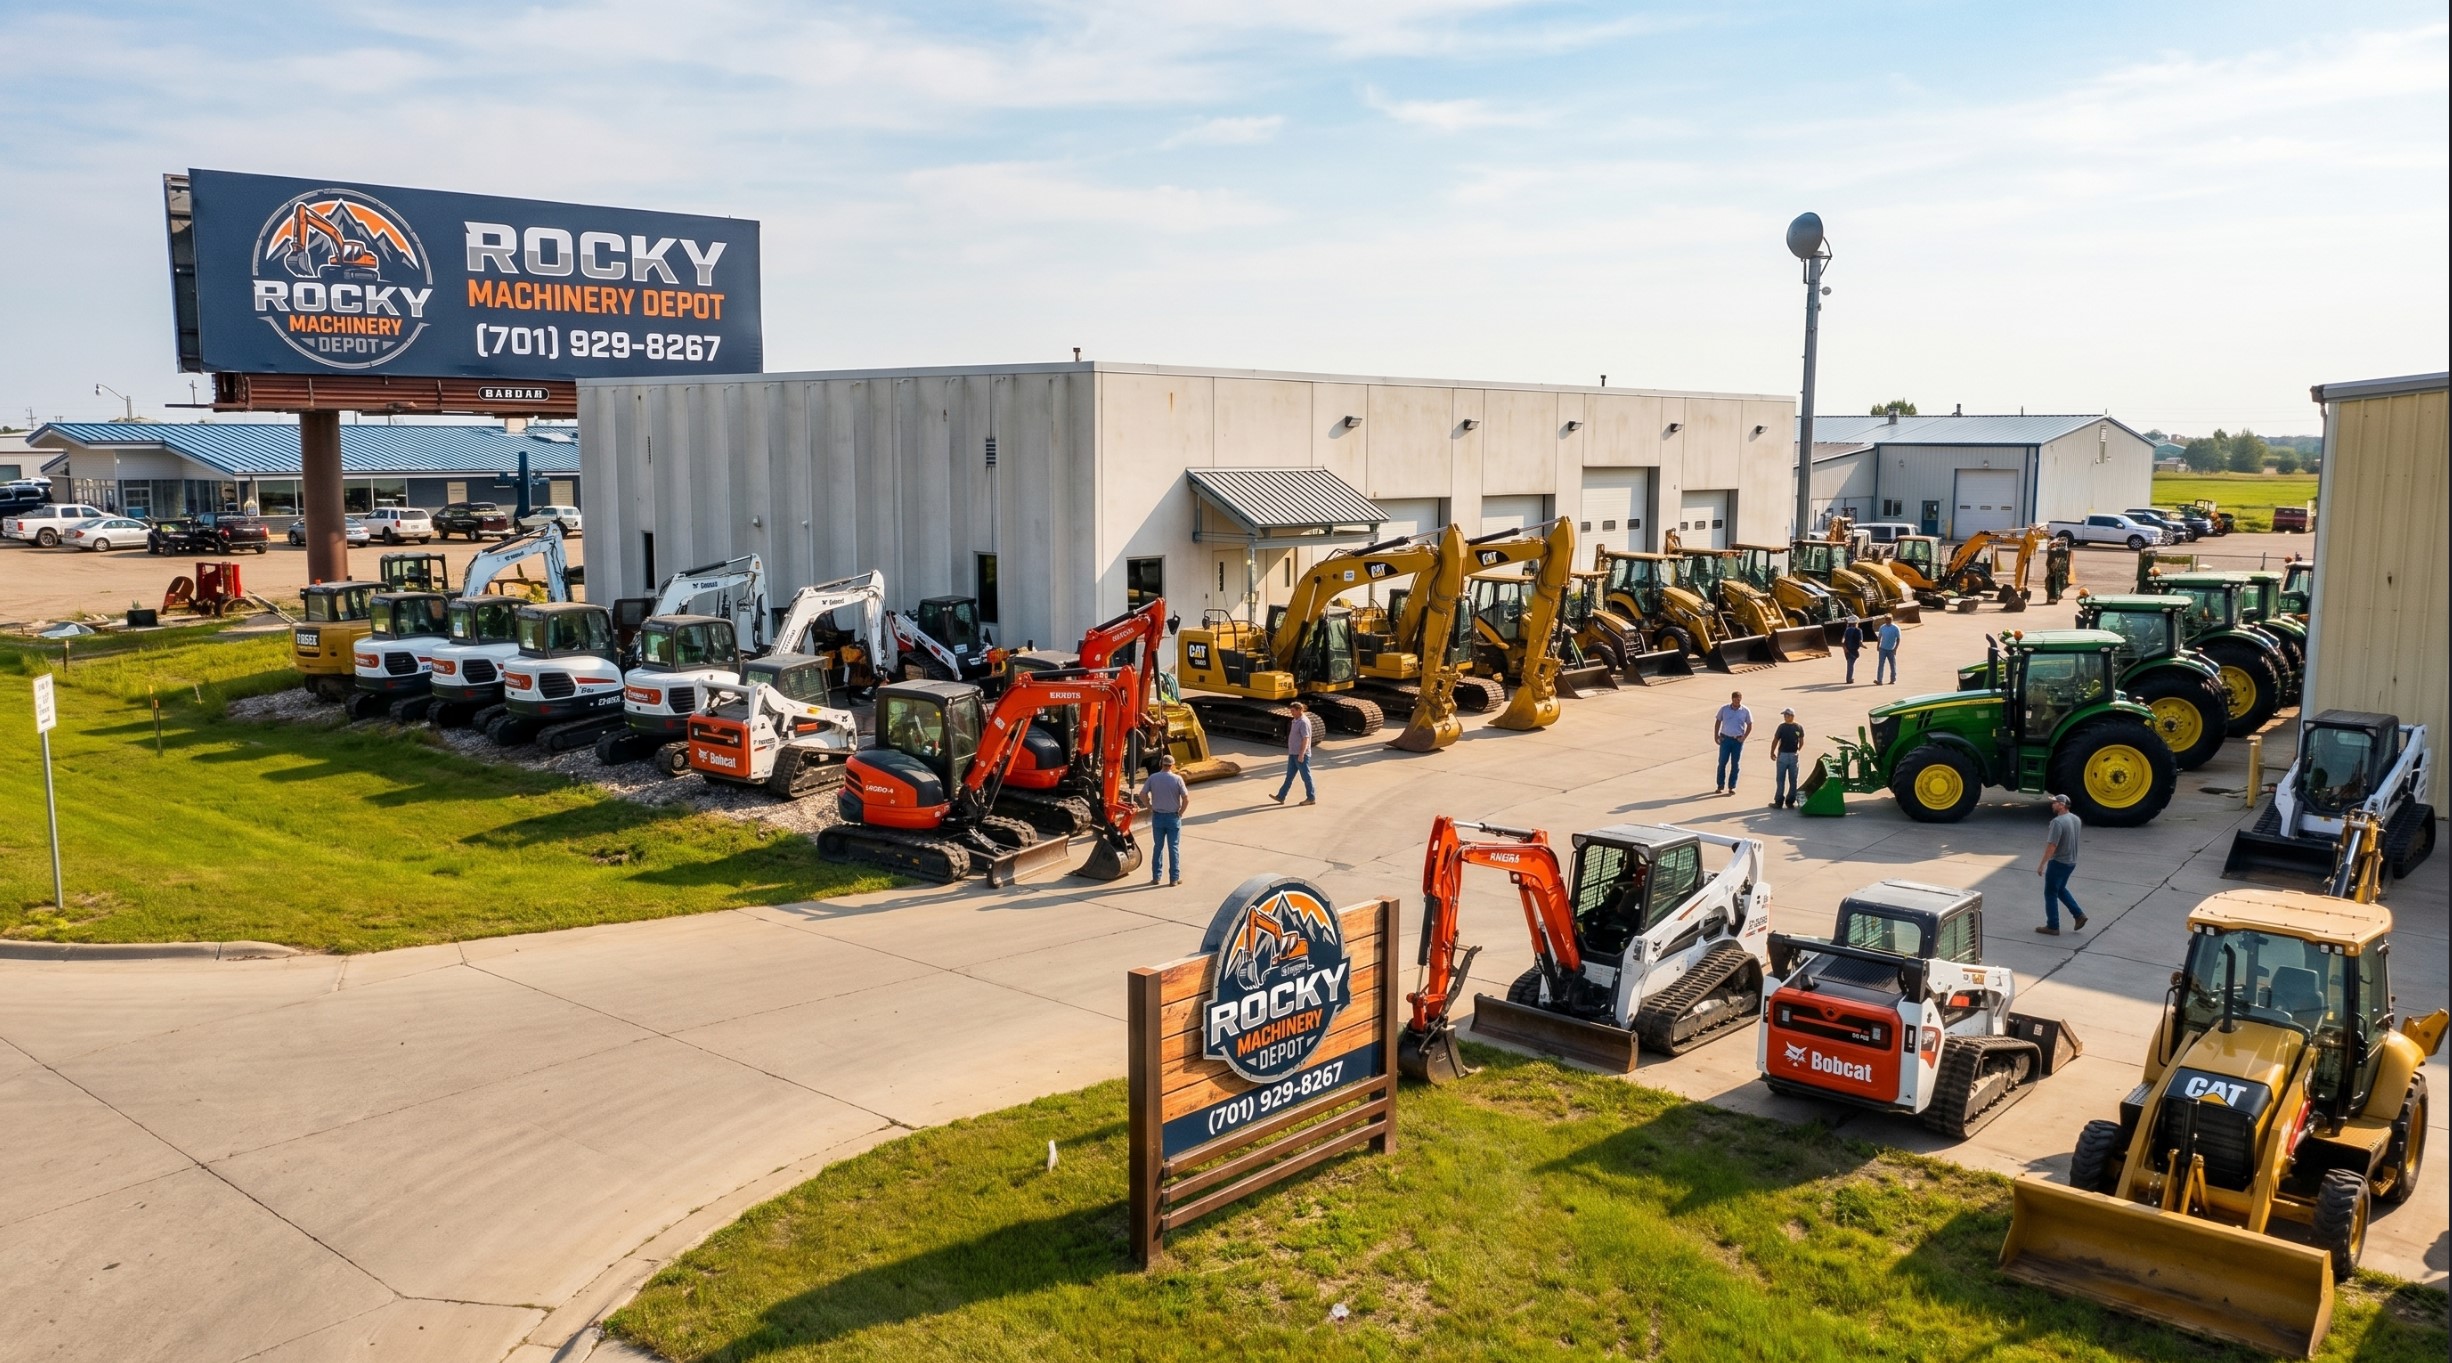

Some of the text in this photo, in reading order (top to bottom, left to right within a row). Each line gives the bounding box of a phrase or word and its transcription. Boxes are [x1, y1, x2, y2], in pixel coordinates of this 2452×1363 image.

[464, 221, 728, 287] ROCKY
[252, 279, 433, 318] ROCKY
[467, 278, 725, 320] MACHINERY DEPOT
[288, 314, 403, 336] MACHINERY
[476, 322, 722, 362] (701) 929-8267
[318, 336, 380, 354] DEPOT
[1189, 644, 1207, 659] CAT
[1210, 962, 1348, 1047] ROCKY
[1236, 1008, 1324, 1059] MACHINERY
[1259, 1036, 1305, 1071] DEPOT
[1811, 1050, 1873, 1083] Bobcat
[1208, 1060, 1344, 1136] (701) 929-8267
[2184, 1076, 2248, 1108] CAT
